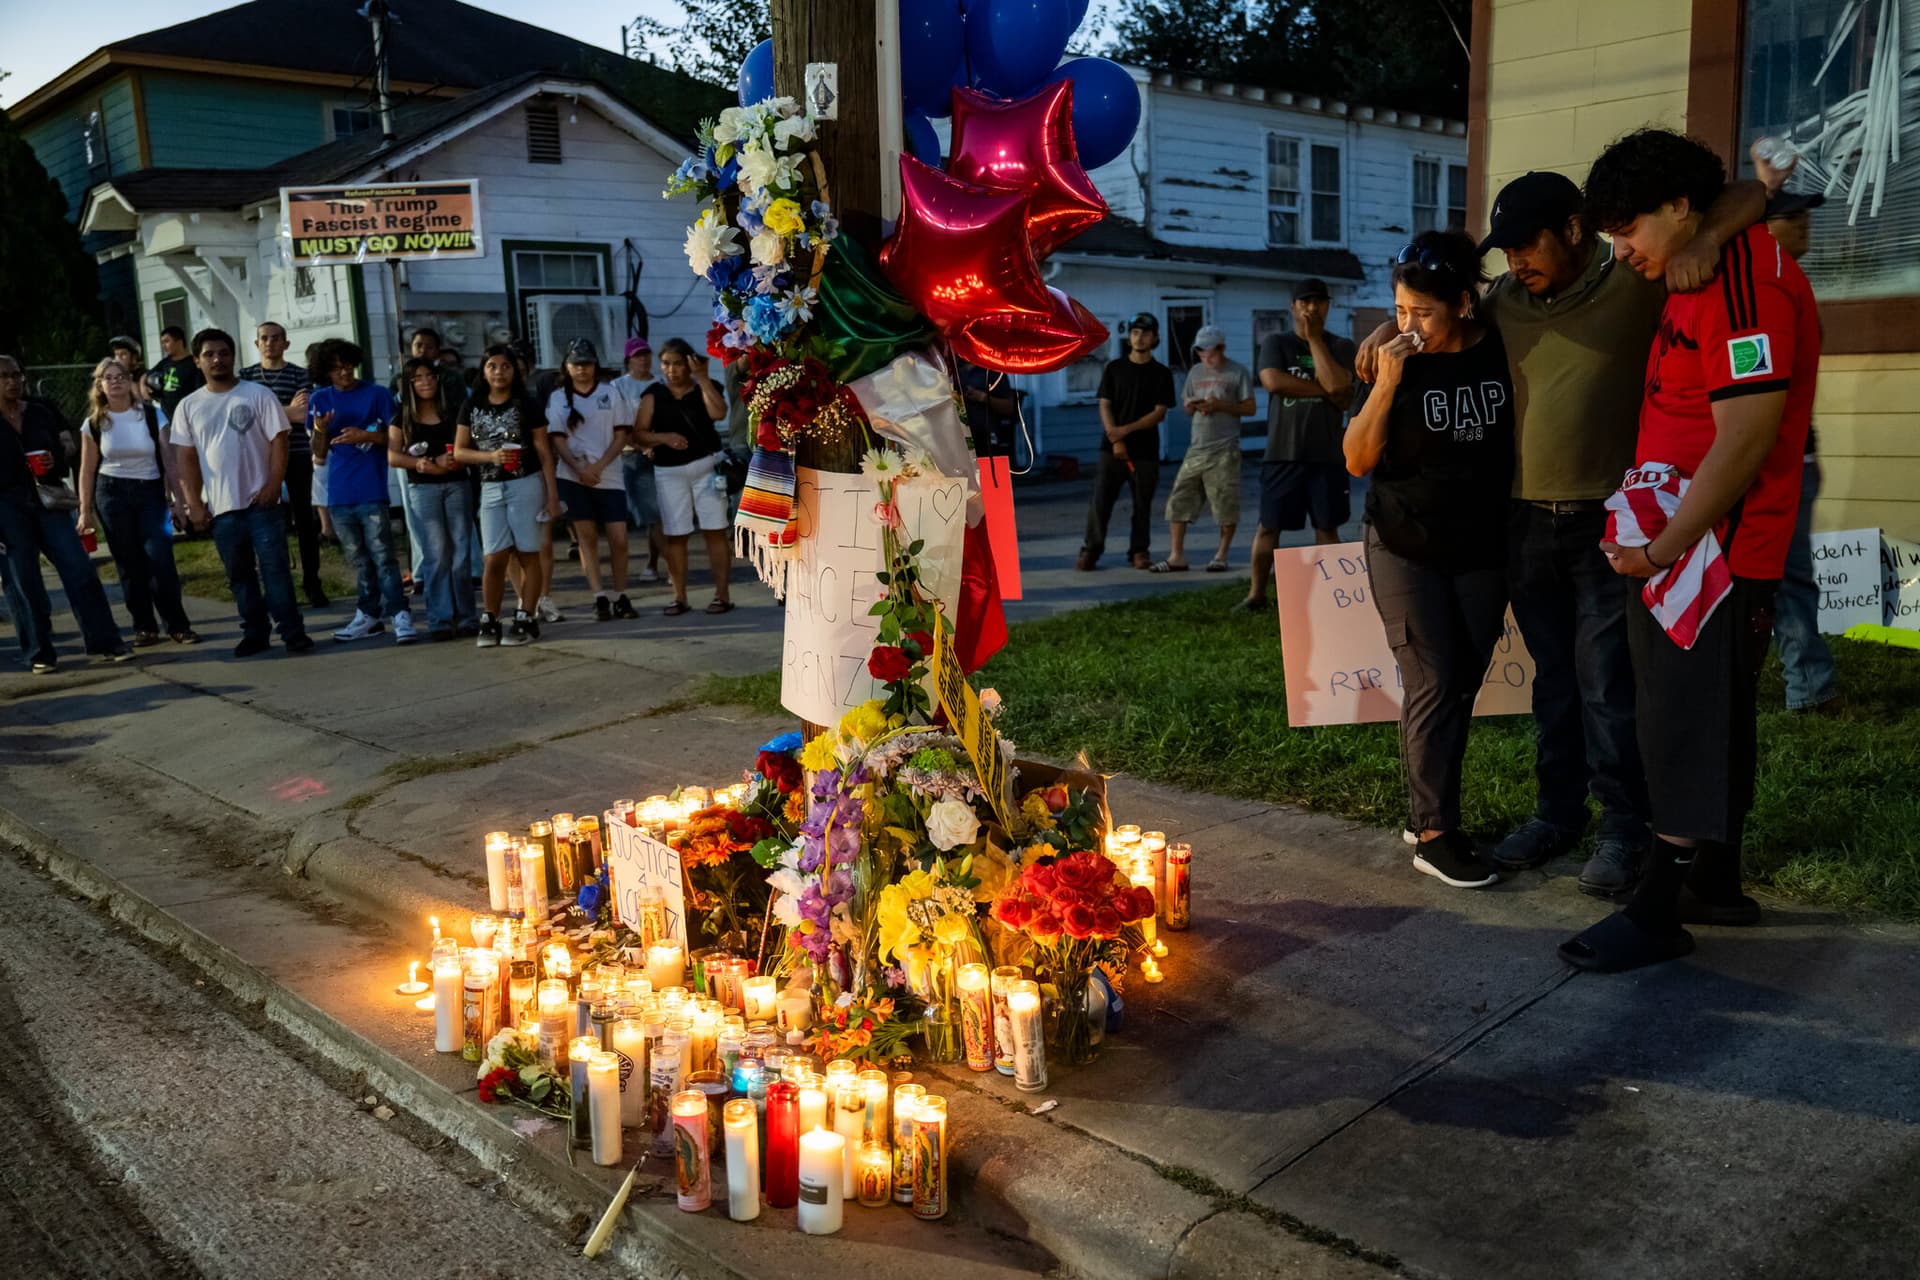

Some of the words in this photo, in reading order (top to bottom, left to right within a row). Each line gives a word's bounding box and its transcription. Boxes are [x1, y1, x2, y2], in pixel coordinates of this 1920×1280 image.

[327, 201, 365, 214] The
[373, 199, 438, 214] Trump
[303, 216, 378, 232] Fascist
[385, 213, 462, 231] Regime
[301, 237, 360, 255] MUST
[367, 235, 399, 252] GO
[404, 231, 470, 249] NOW!!!
[1424, 381, 1505, 431] GAP
[1314, 559, 1332, 581] I
[610, 820, 680, 888] JUSTICE
